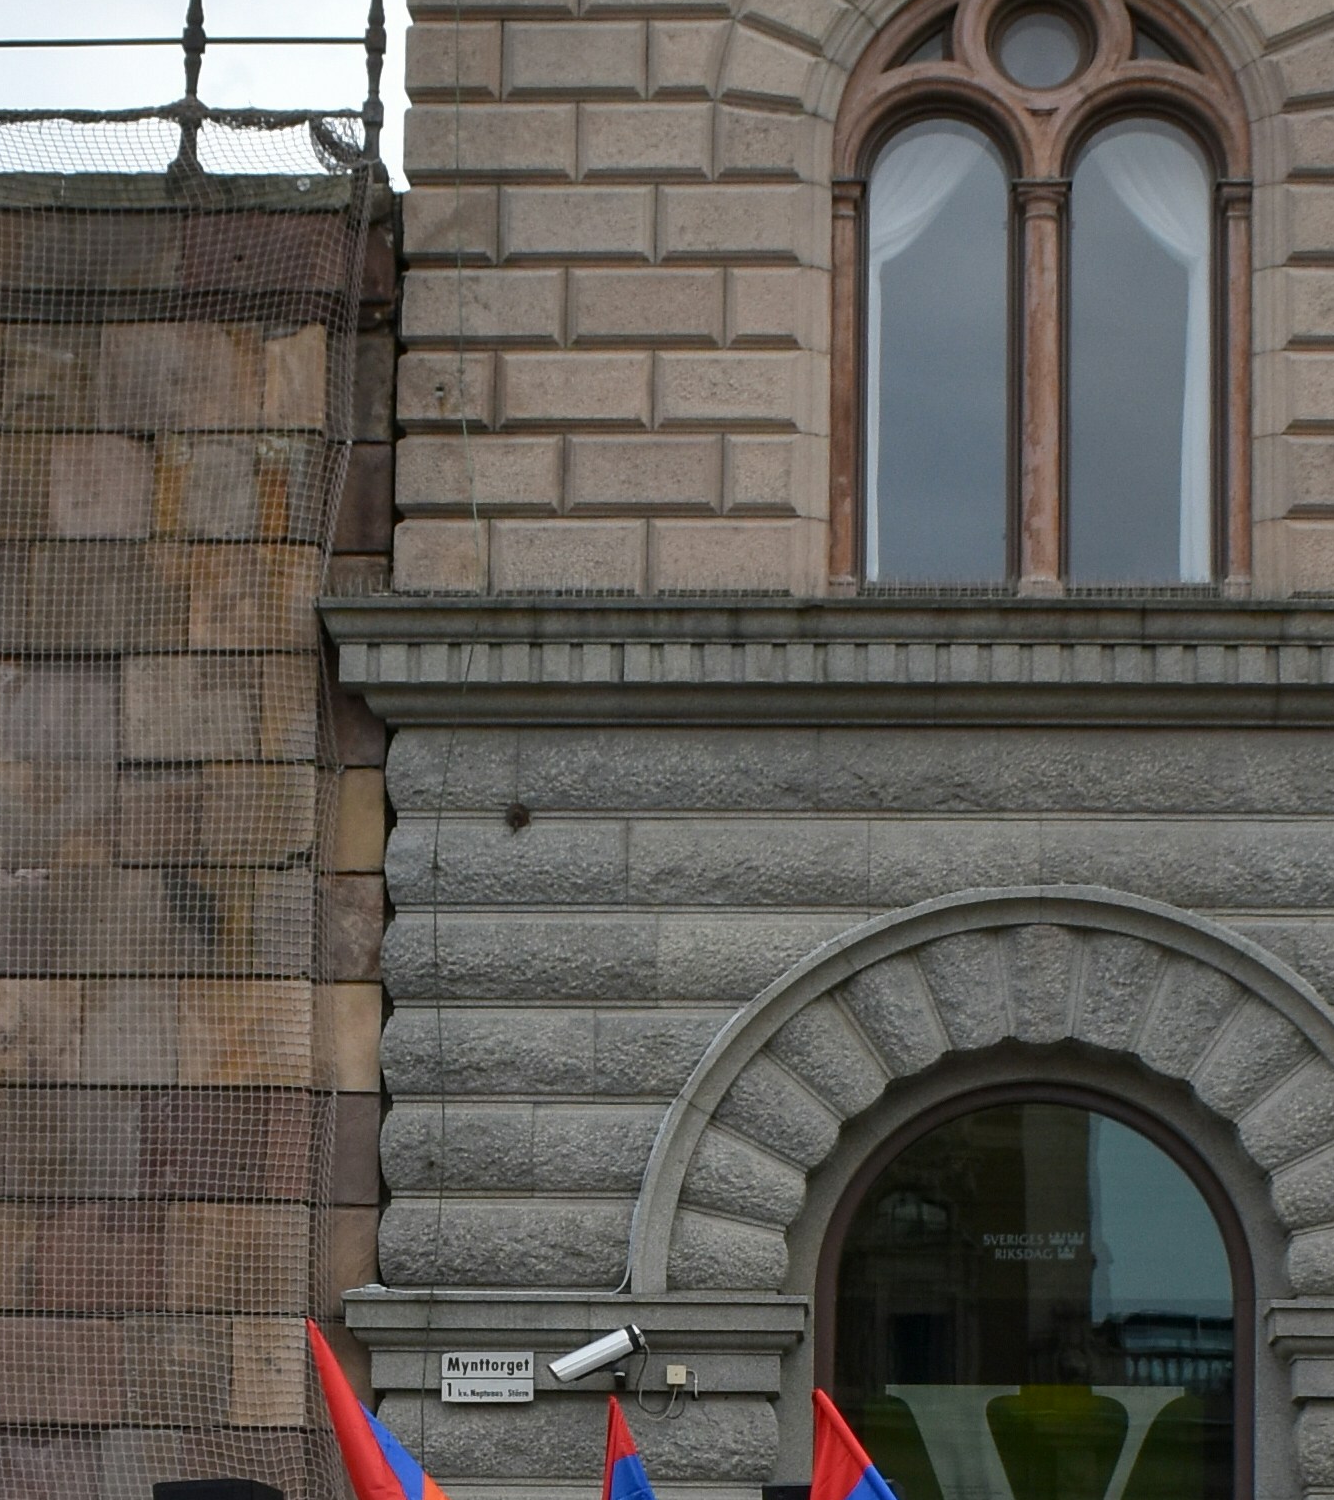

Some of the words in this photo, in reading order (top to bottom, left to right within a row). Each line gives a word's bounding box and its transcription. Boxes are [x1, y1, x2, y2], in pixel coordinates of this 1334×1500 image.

[983, 1233, 1044, 1246] SVERIGES
[994, 1247, 1053, 1260] RIKSDAG
[447, 1357, 530, 1376] Mynttorget
[447, 1382, 452, 1398] 1
